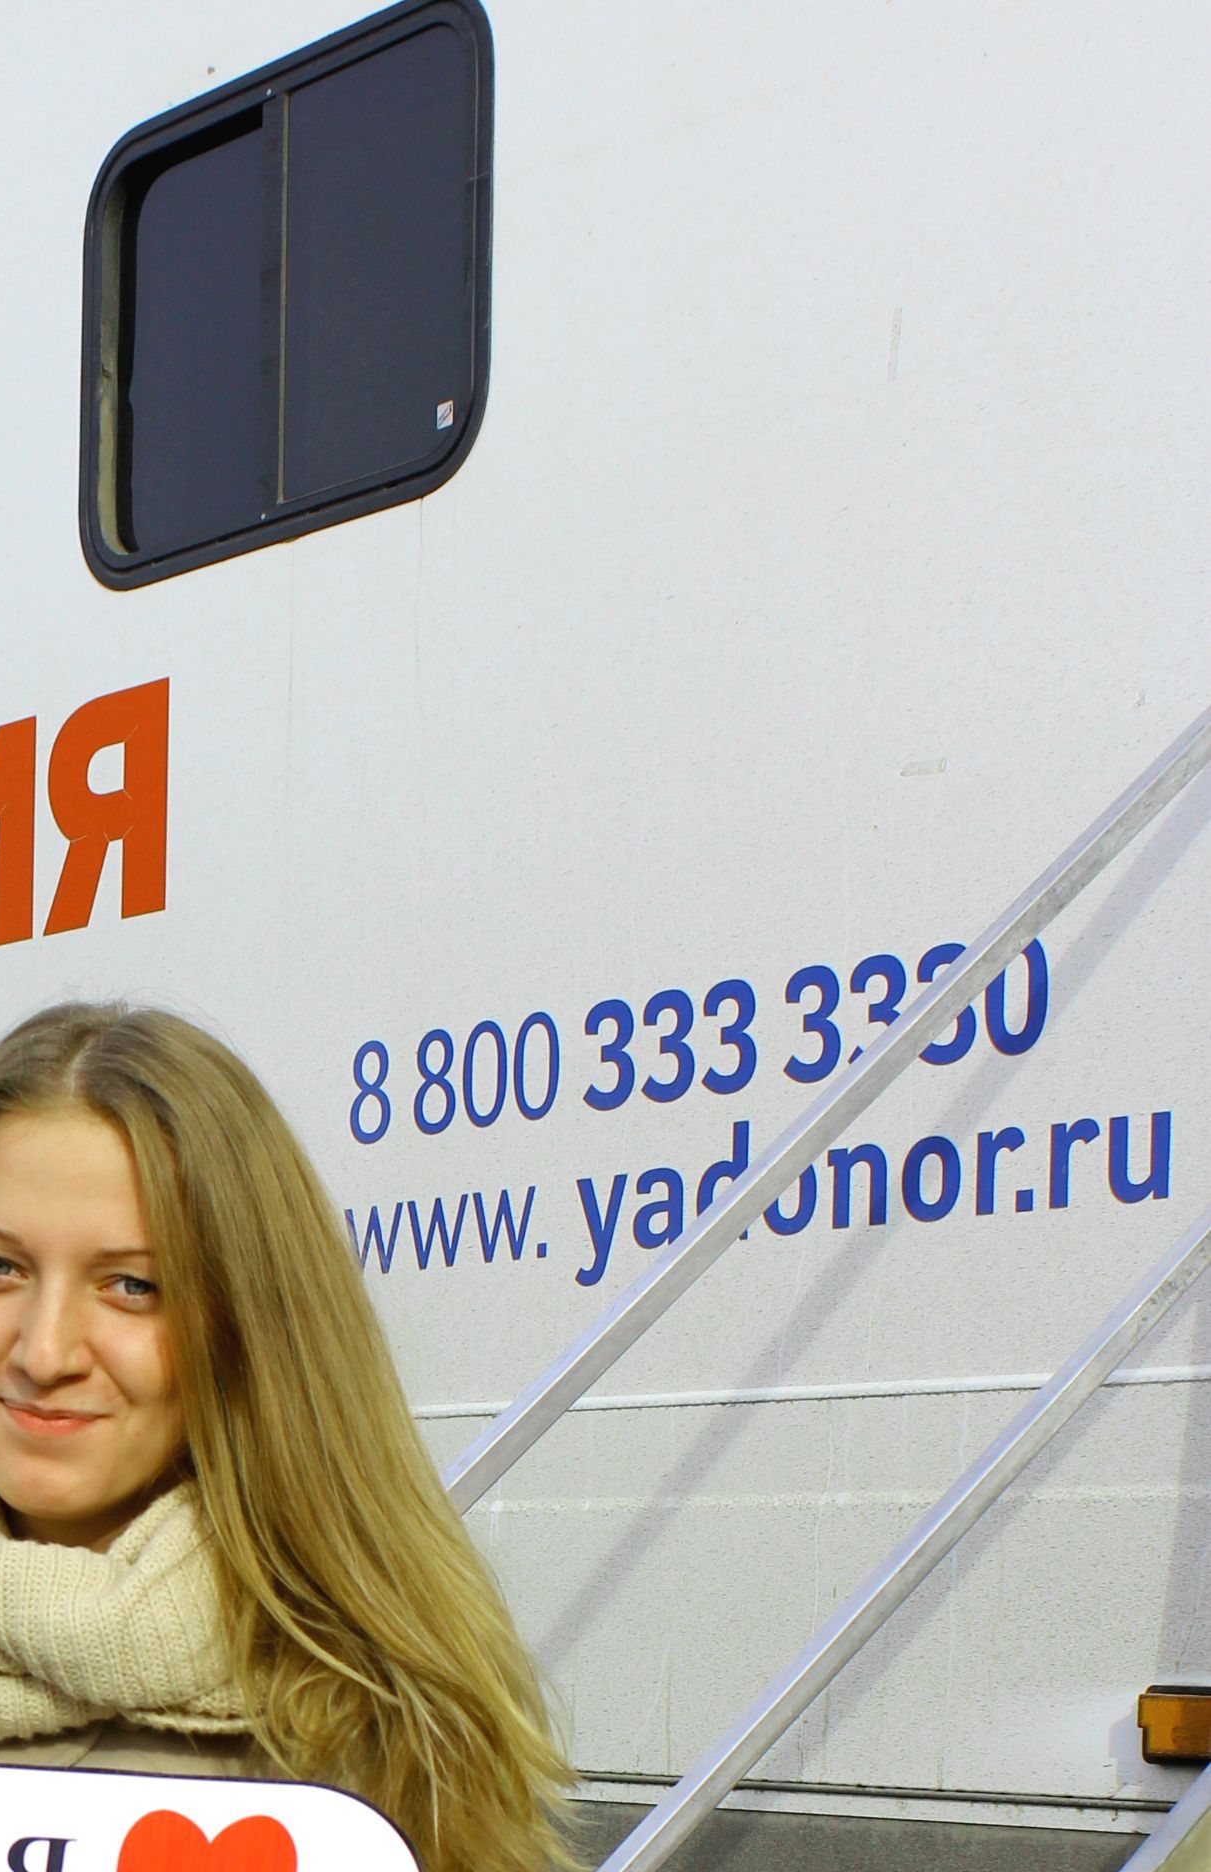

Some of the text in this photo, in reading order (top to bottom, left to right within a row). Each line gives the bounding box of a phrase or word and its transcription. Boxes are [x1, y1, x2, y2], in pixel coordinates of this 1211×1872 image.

[349, 1040, 391, 1145] 8
[413, 1010, 560, 1135] 800
[582, 978, 757, 1111] 333
[344, 1110, 1172, 1287] www. yadonor.ru
